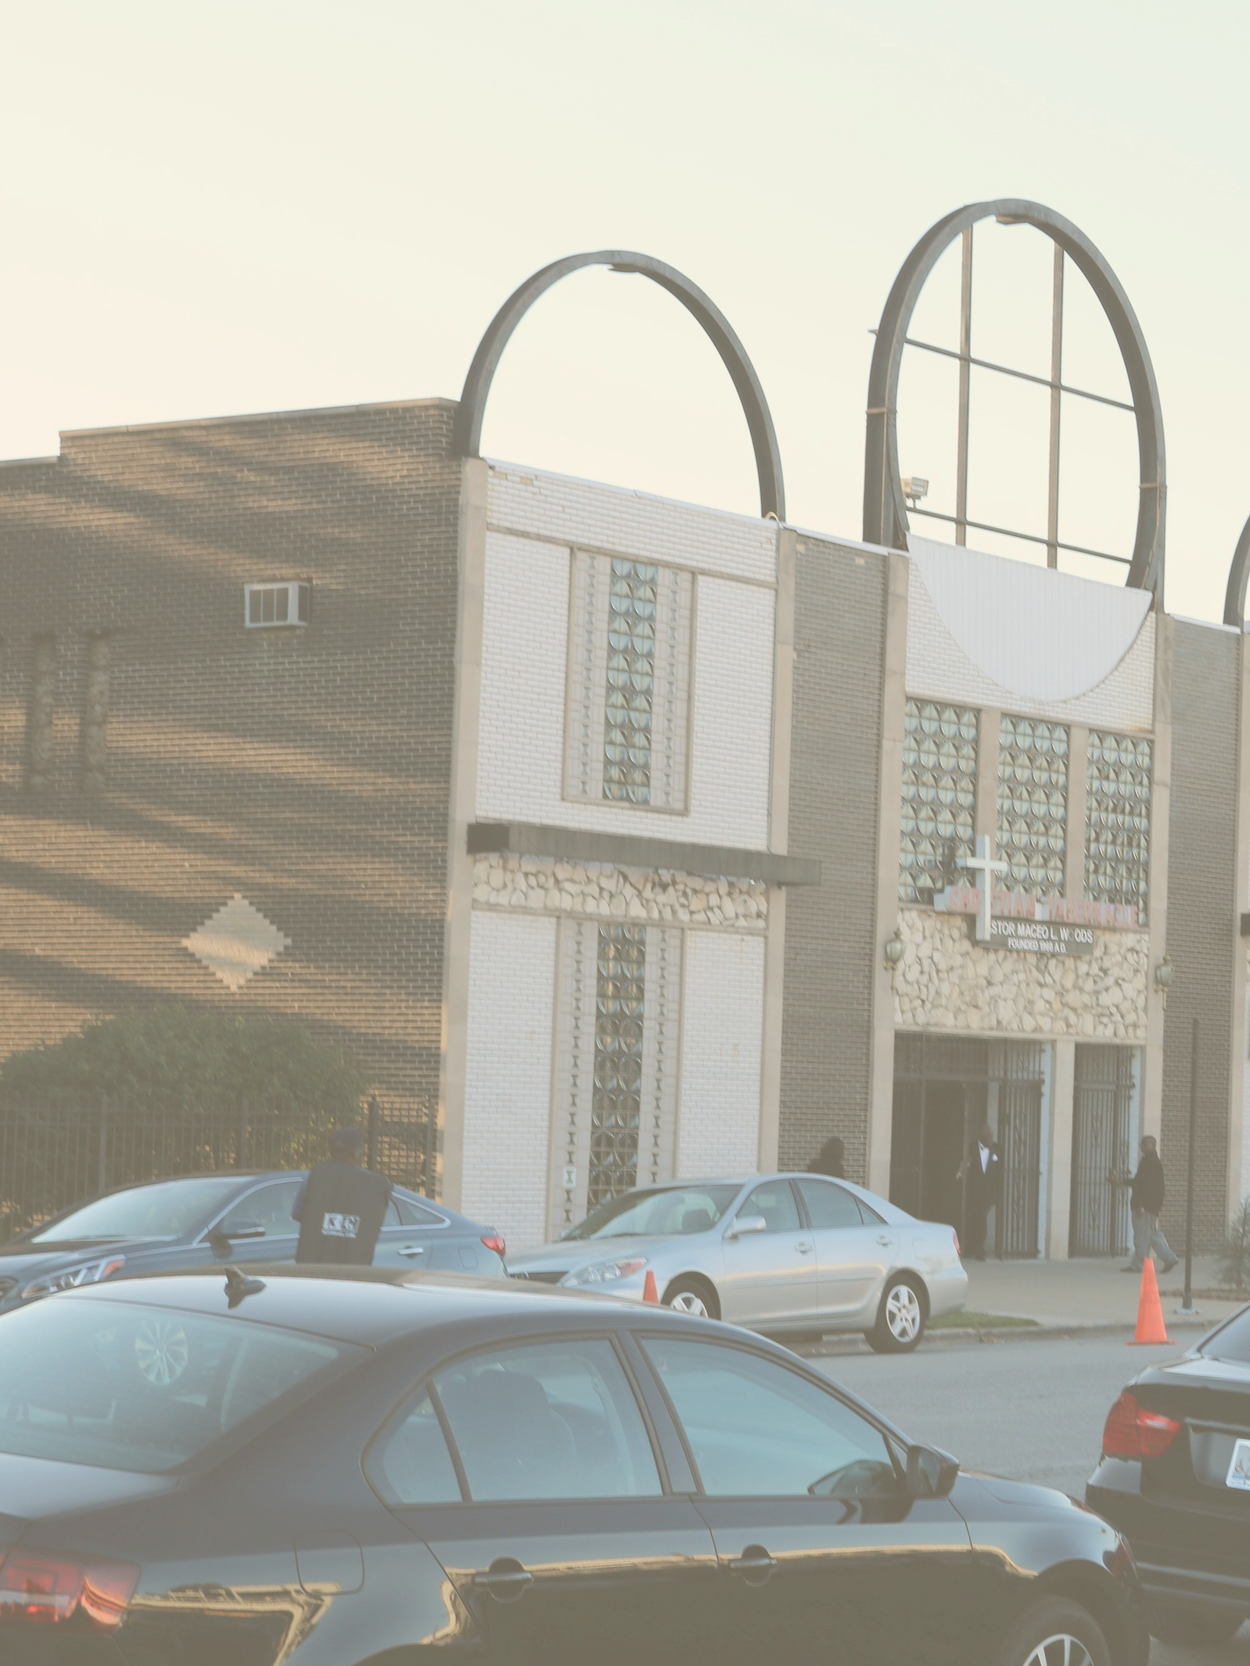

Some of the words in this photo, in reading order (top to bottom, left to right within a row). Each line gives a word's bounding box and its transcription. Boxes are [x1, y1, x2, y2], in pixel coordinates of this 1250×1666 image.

[950, 885, 1036, 919] CHRSTIAN
[1047, 896, 1138, 930] TABERNACLE
[1017, 922, 1049, 940] MACEO
[1008, 937, 1038, 951] FOUNDED
